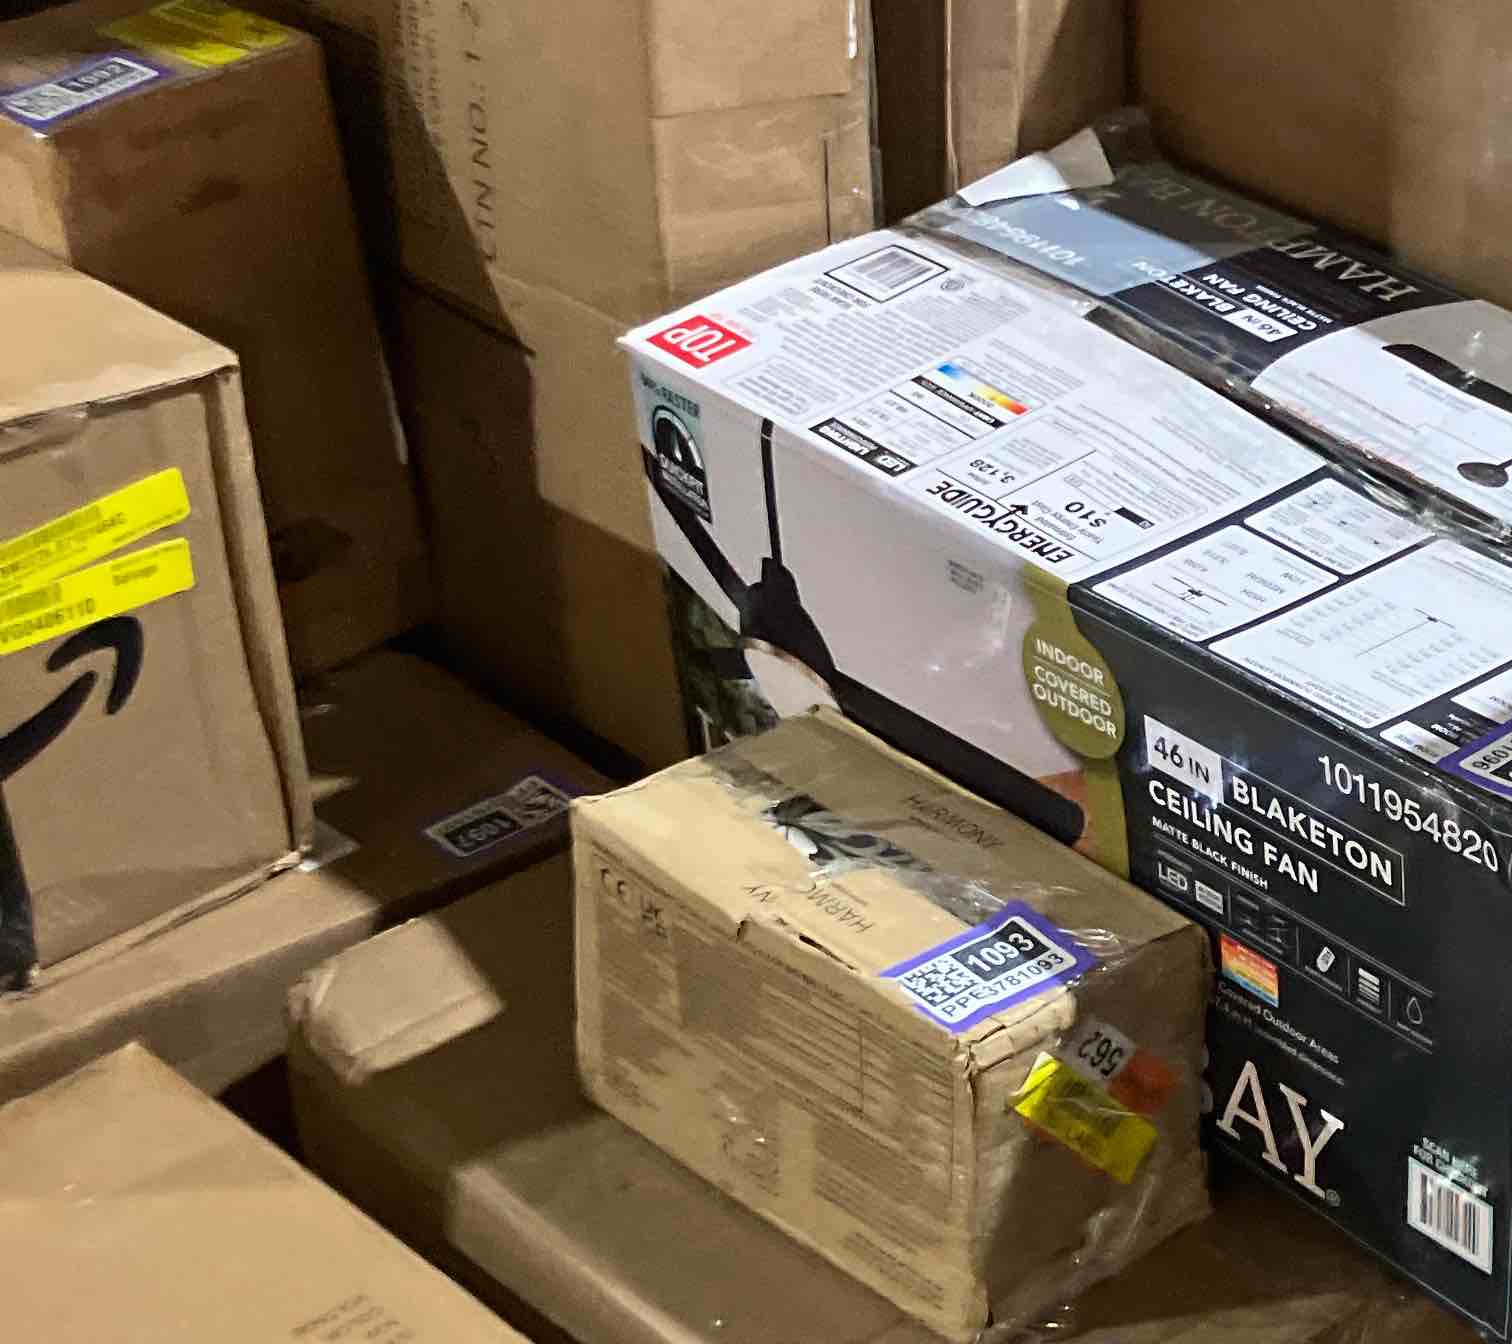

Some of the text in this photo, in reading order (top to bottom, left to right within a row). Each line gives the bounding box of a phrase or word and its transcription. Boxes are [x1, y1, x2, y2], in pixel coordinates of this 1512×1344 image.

[1190, 273, 1338, 330] CEILING FAN
[657, 318, 746, 362] TOP
[968, 458, 1017, 483] 3,128
[924, 480, 1074, 565] ENERGYGUIDE
[1064, 500, 1110, 532] $10
[1035, 637, 1108, 686] INDOOR
[1032, 682, 1119, 739] OUTDOOR
[1034, 664, 1114, 718] COVERED
[907, 793, 1005, 850] HARMONY
[1147, 780, 1319, 894] CEILING FAN
[1152, 735, 1395, 886] 46 IN BLAKETON
[1316, 753, 1501, 875] 1011954820
[1152, 817, 1269, 891] MATTE BLACK FINISH
[1157, 861, 1188, 893] LED
[966, 931, 1035, 974] 1093
[941, 952, 1066, 1018] PPE3781093
[1076, 1029, 1125, 1077] 562
[1263, 1008, 1308, 1044] Outdoor
[1216, 1059, 1346, 1200] AY
